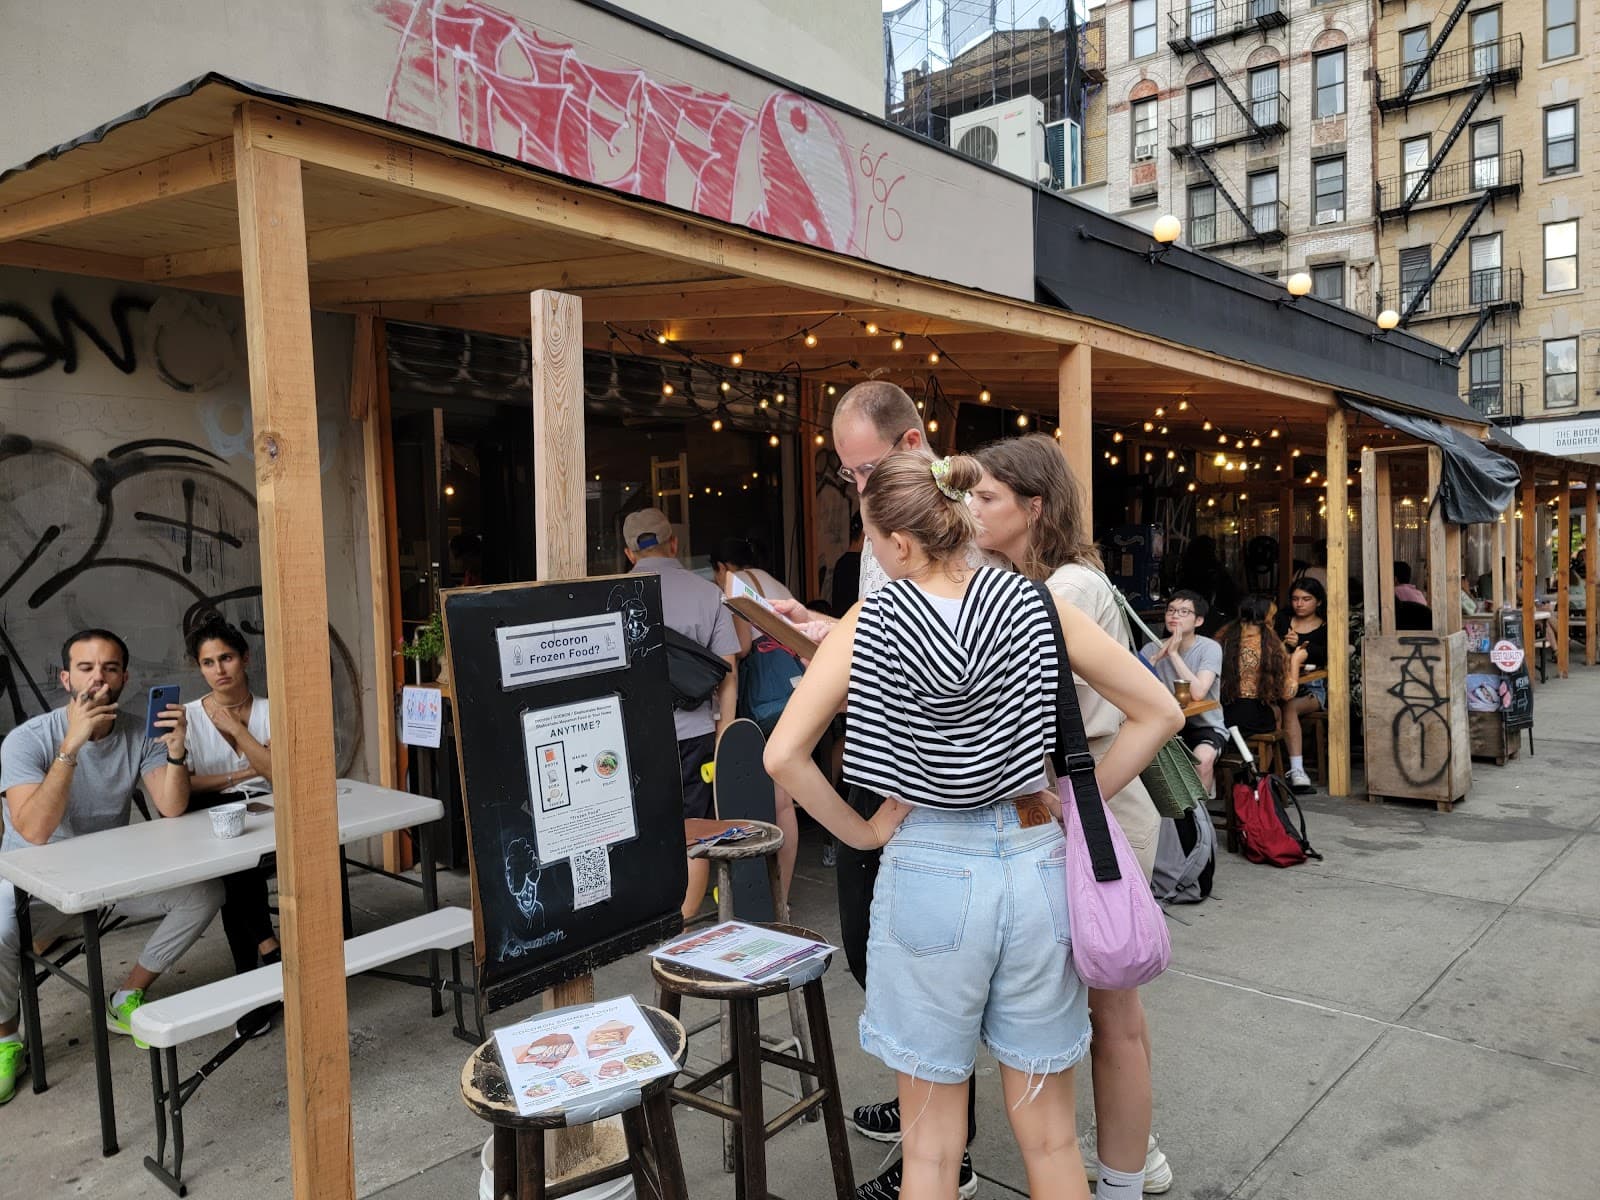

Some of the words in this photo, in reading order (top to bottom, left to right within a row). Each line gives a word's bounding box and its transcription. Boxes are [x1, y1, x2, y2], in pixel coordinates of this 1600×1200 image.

[1556, 430, 1570, 439] THE
[1573, 428, 1600, 437] BUTCH
[1556, 437, 1598, 446] DAUGHTER
[540, 635, 588, 650] cocoron
[530, 651, 566, 665] Frozen
[569, 645, 600, 659] Food?
[550, 720, 601, 738] ANYTIME?
